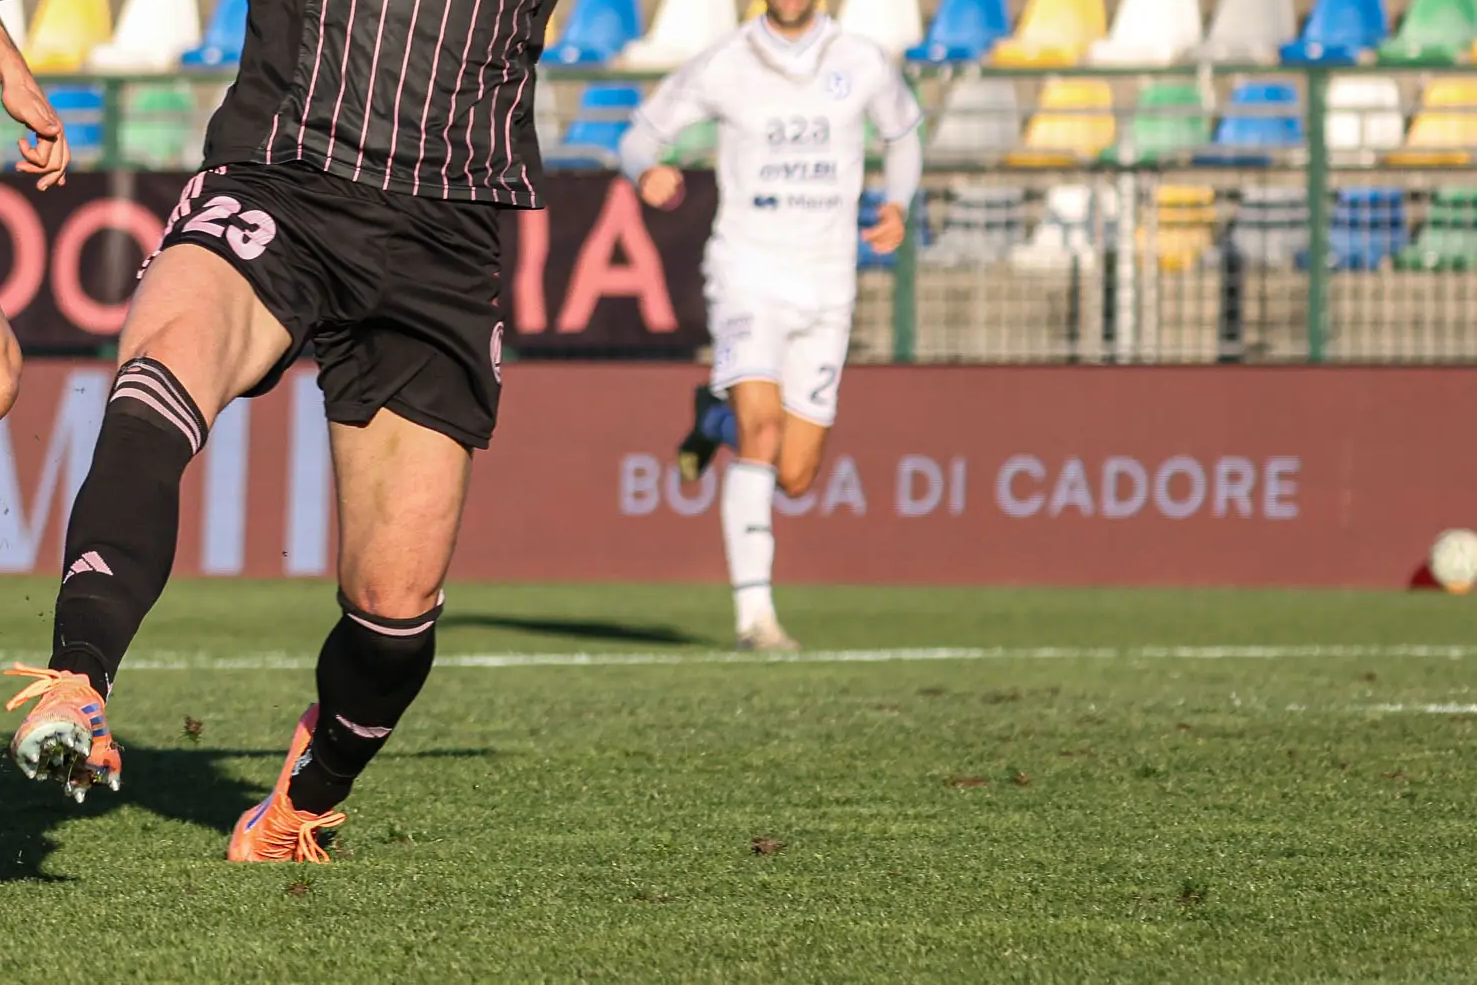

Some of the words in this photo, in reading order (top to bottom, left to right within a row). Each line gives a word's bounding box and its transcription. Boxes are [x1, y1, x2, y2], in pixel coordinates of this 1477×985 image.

[184, 196, 277, 260] 23
[897, 456, 966, 516] DI
[996, 455, 1301, 519] CADORE
